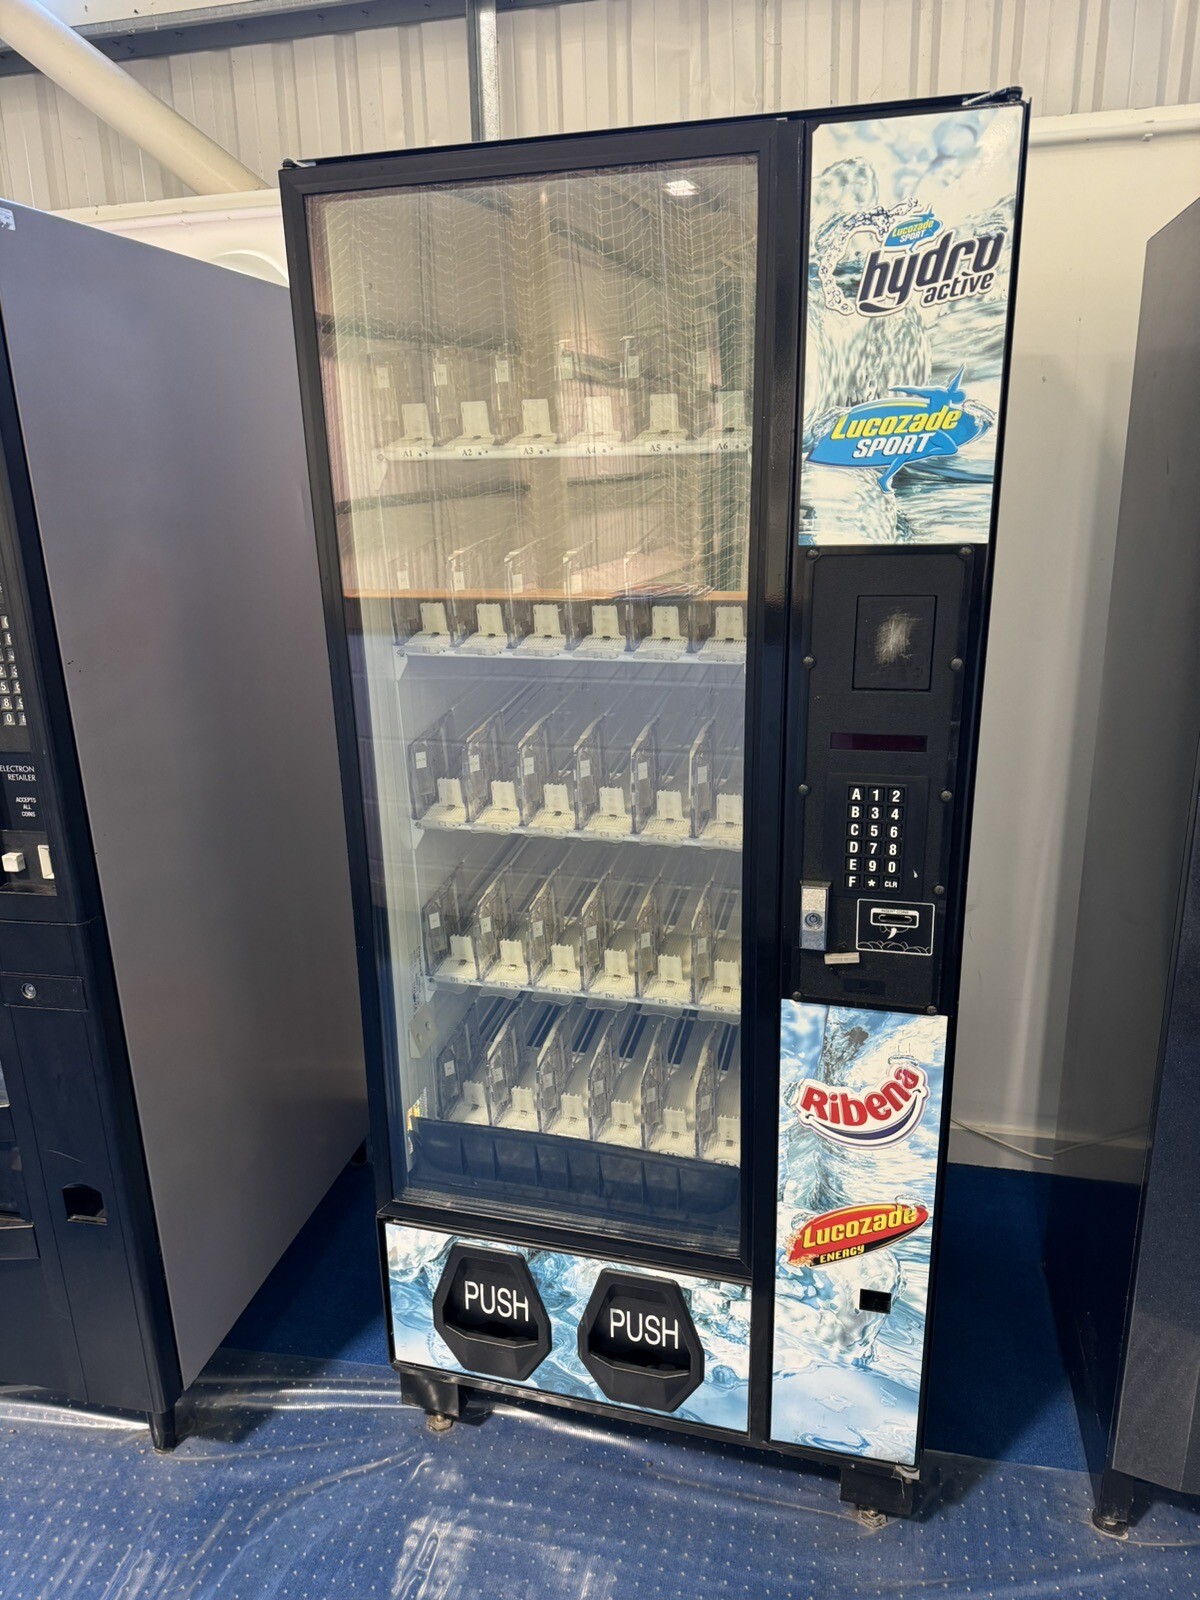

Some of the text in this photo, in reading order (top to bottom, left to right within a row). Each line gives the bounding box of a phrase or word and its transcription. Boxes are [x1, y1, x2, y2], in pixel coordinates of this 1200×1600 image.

[892, 219, 934, 238] Lucozade
[900, 230, 926, 242] SPORT
[857, 231, 1005, 313] hydro
[924, 271, 995, 304] active
[830, 405, 962, 440] Lucozade
[462, 449, 472, 457] A2
[523, 447, 534, 455] A3
[650, 443, 661, 452] A5
[852, 432, 938, 459] SPORT
[8, 773, 37, 781] RETAILER
[852, 788, 901, 803] A 1 2
[851, 806, 900, 821] B 3 4
[850, 824, 898, 838] C 5 6
[850, 841, 897, 856] D 7 8
[849, 859, 896, 873] E 9 0
[849, 876, 898, 888] F CLR
[800, 1068, 920, 1127] Ribena
[802, 1204, 918, 1249] Lucozade
[819, 1244, 865, 1264] ENERGY
[464, 1280, 529, 1322] PUSH
[610, 1308, 679, 1349] PUSH
